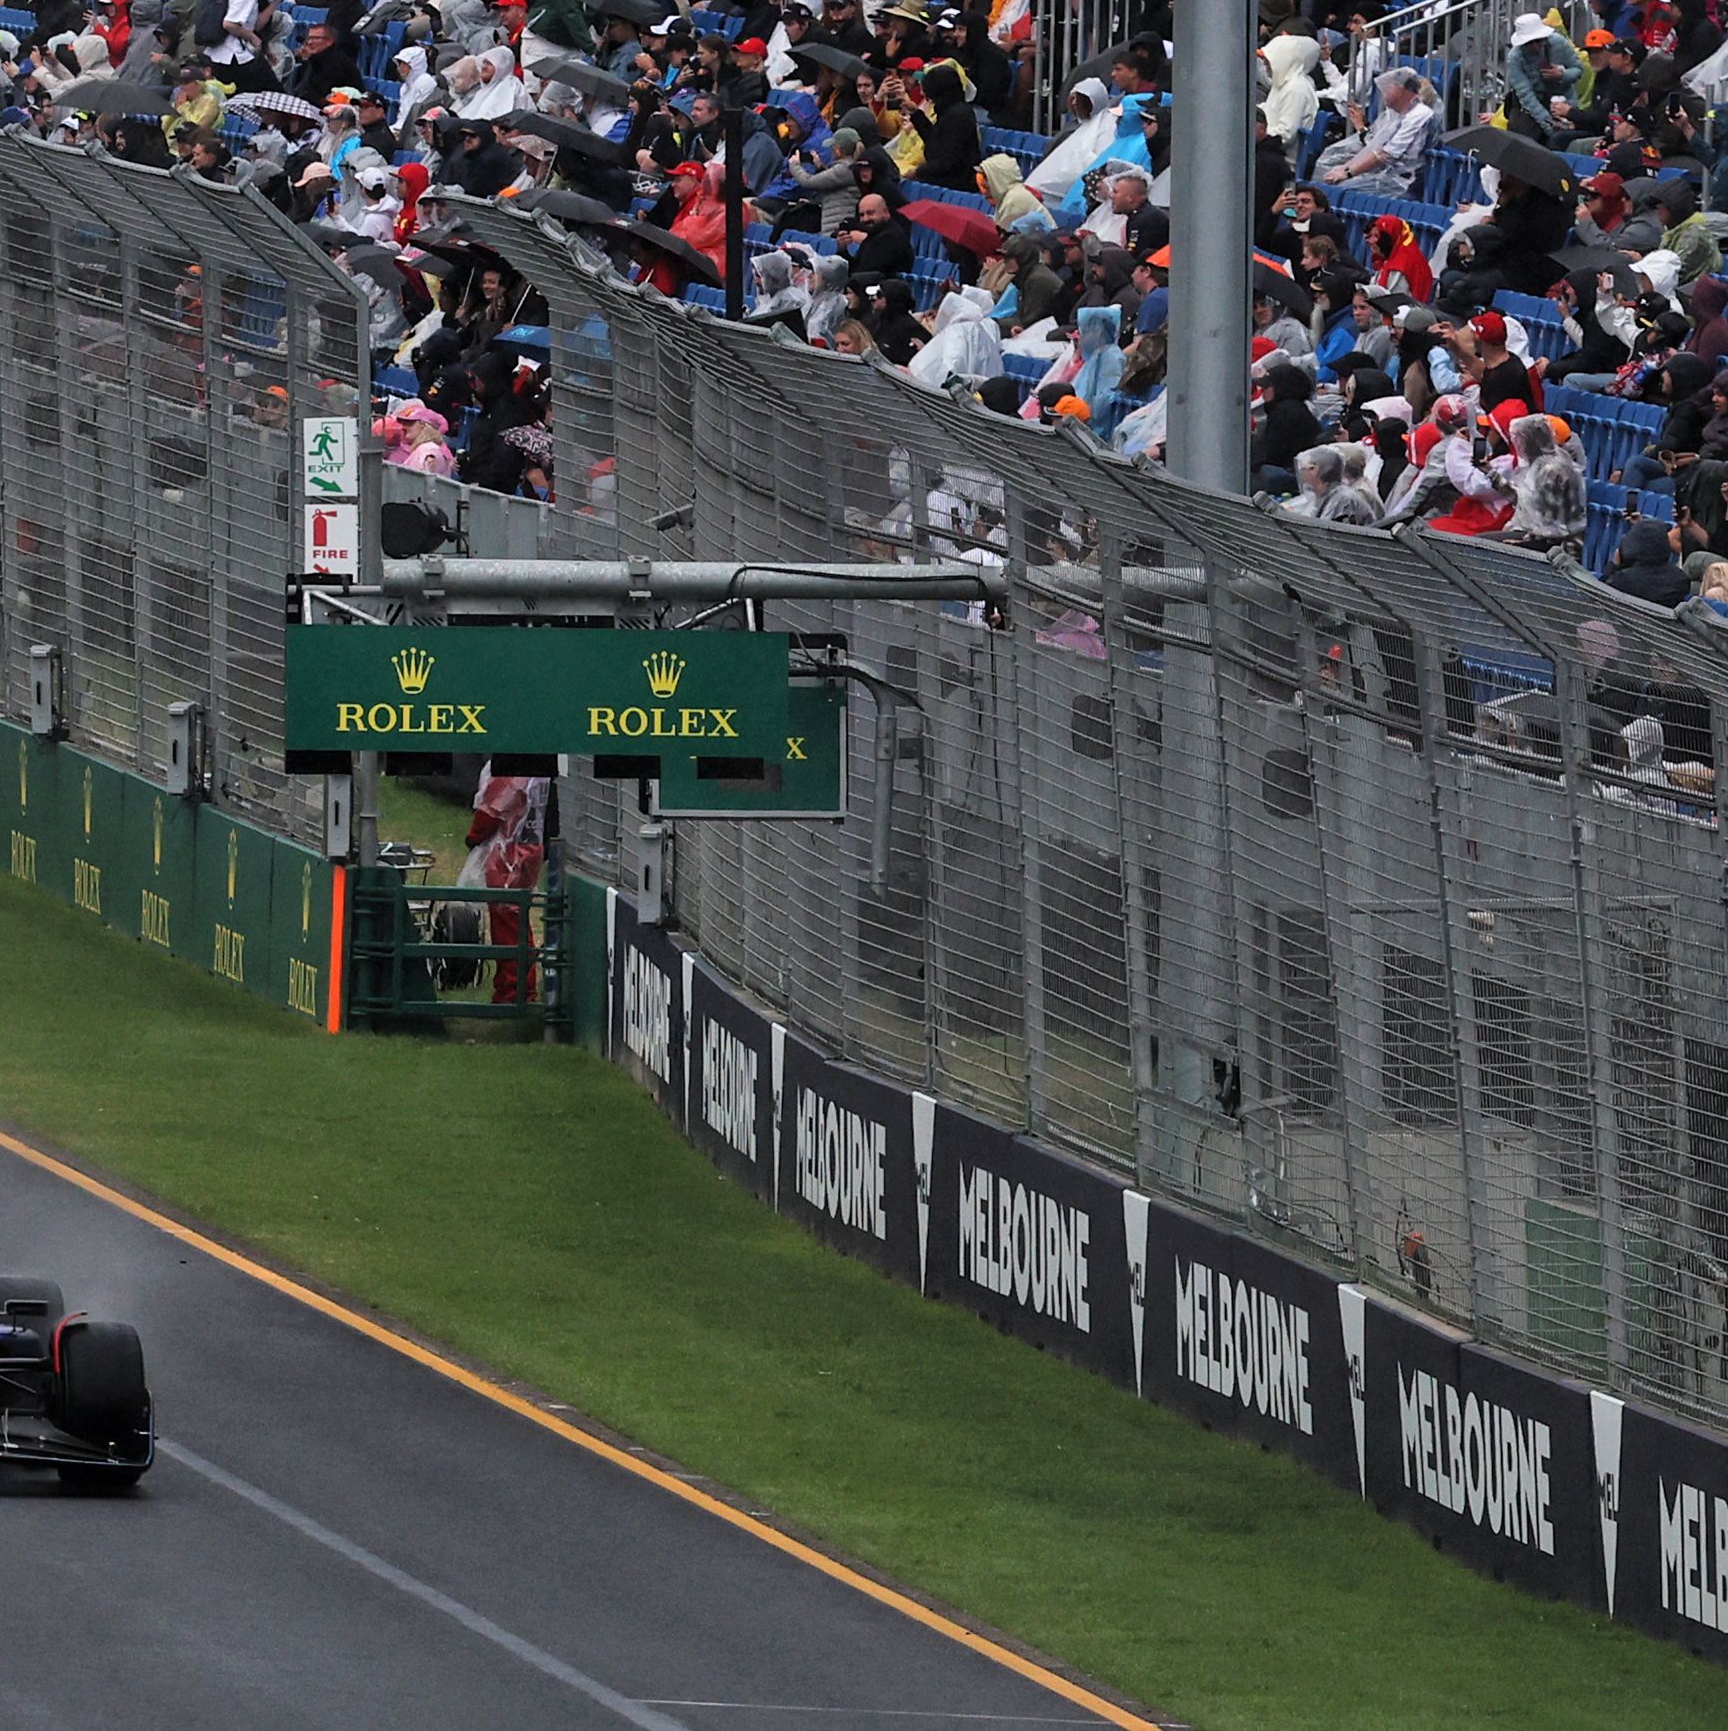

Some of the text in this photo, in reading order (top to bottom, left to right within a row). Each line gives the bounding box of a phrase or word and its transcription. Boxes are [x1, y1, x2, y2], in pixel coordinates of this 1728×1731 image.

[308, 464, 344, 474] EXIT
[313, 549, 349, 559] FIRE
[335, 703, 487, 734] ROLEX
[587, 707, 739, 738] ROLEX
[796, 1083, 886, 1241] MELBOURNE
[959, 1160, 1090, 1334] MELBOURNE
[1175, 1254, 1313, 1436] MELBOURNE
[1397, 1361, 1555, 1556] MELBOURNE
